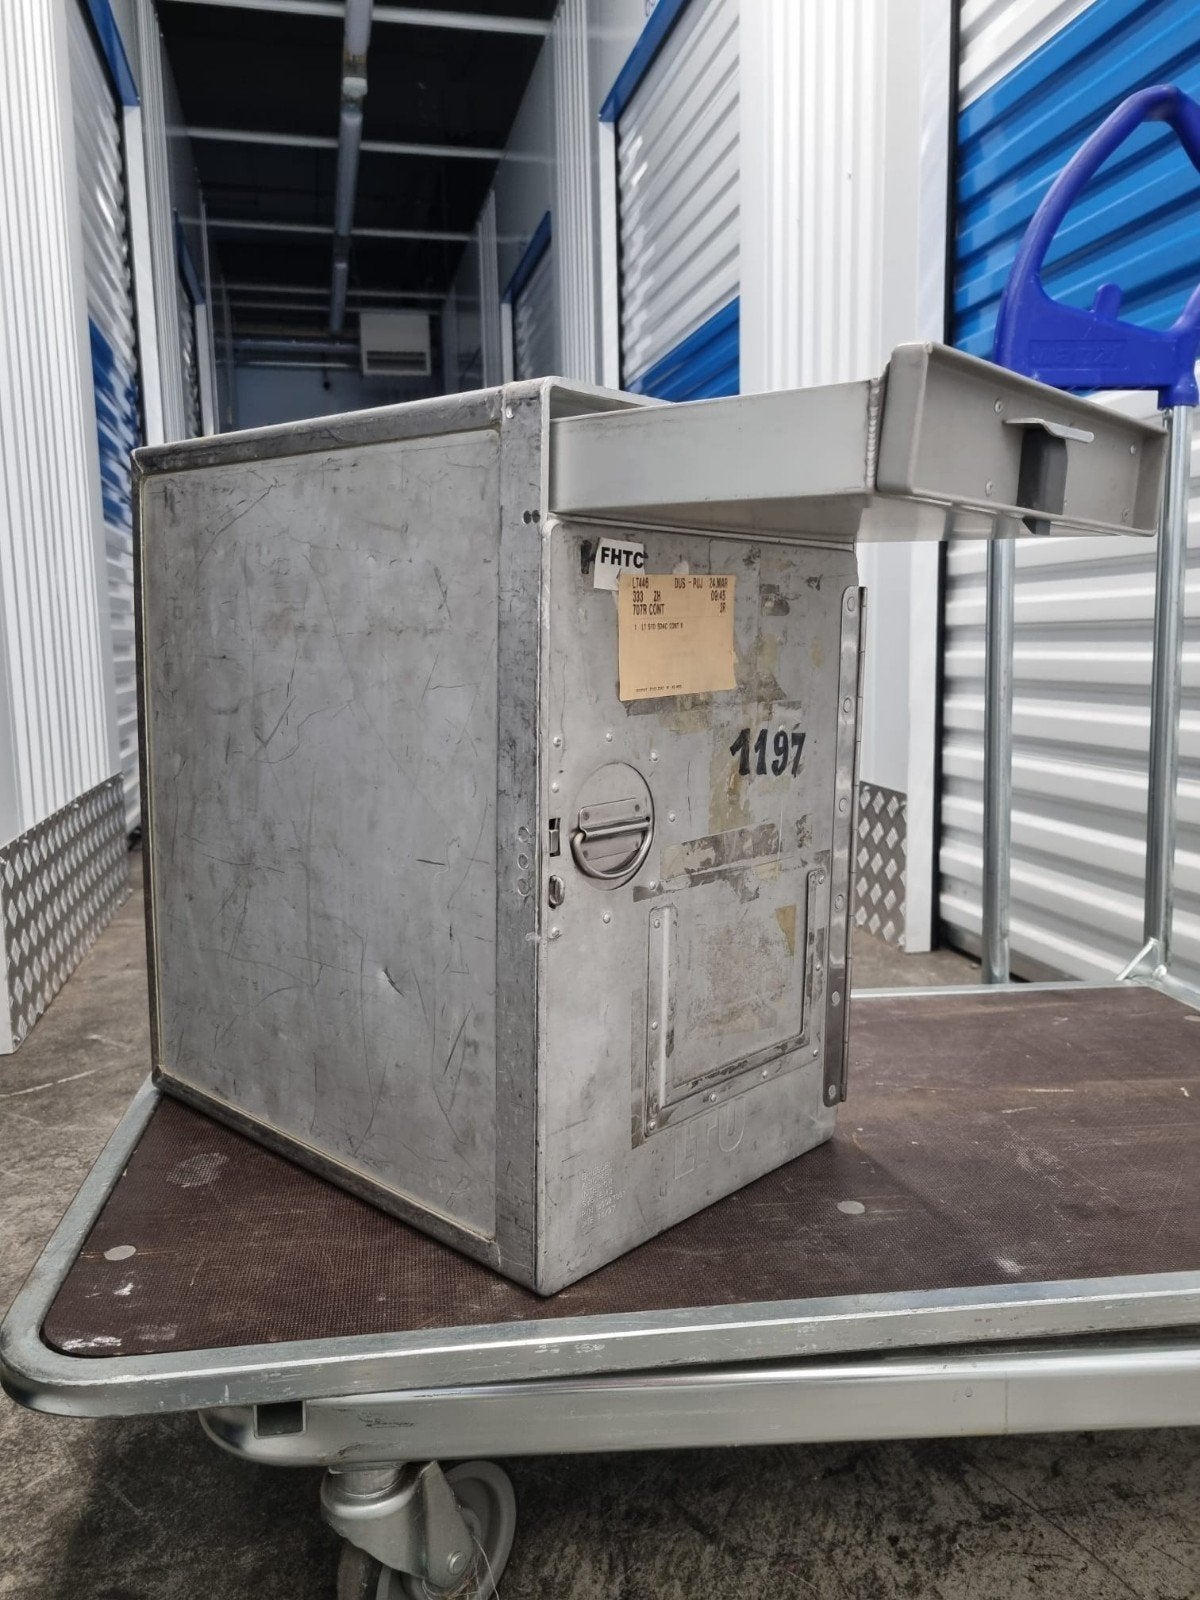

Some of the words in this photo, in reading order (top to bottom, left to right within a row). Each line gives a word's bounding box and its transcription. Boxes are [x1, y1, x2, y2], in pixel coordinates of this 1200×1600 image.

[601, 546, 644, 569] FHTC
[674, 577, 686, 589] DUS
[632, 590, 644, 603] 333
[648, 603, 665, 616] CONT
[729, 728, 806, 778] 1197
[674, 1096, 747, 1180] LTU
